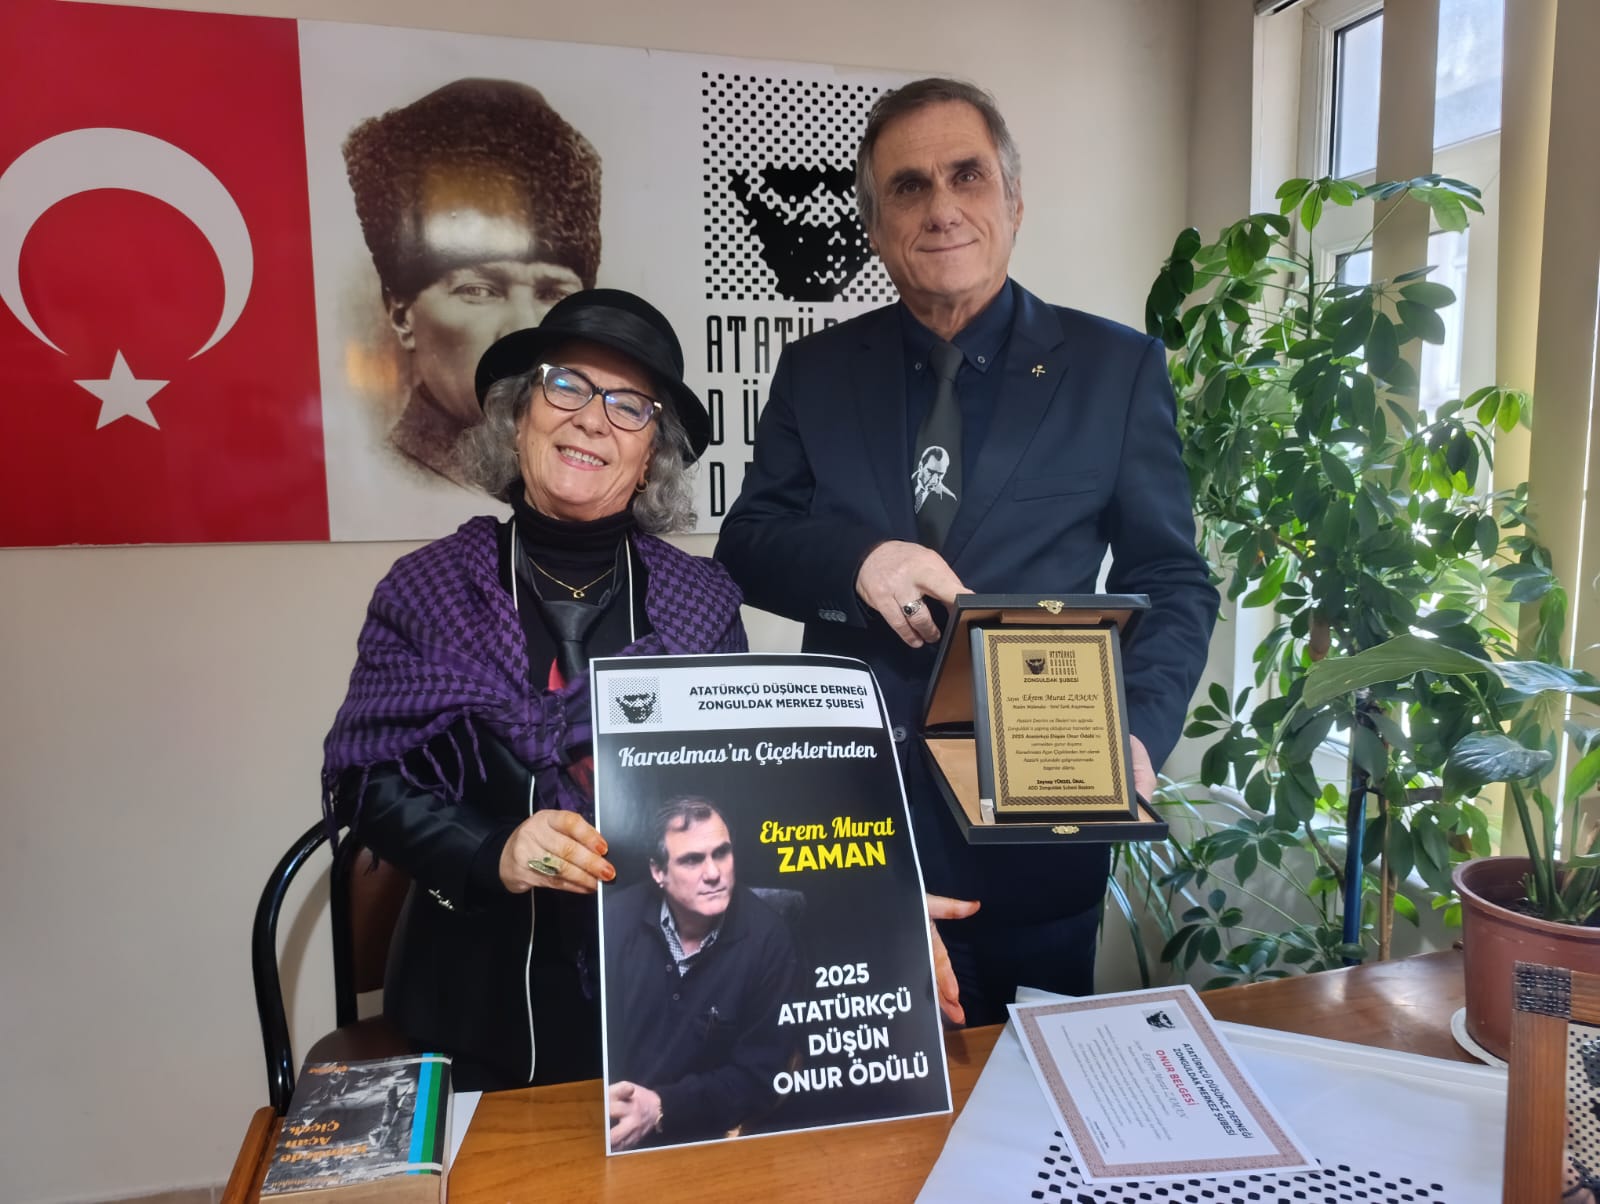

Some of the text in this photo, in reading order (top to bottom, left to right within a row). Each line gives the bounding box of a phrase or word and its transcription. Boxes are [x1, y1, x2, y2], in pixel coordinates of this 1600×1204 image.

[706, 307, 838, 373] ATAT
[689, 682, 867, 697] ATATÜRKÇÜ DÜŞÜNCE DERNEĞİ
[698, 698, 865, 710] ZONGULDAK MERKEZ ŞUBESİ
[755, 740, 877, 765] Çiçeklerinden
[759, 815, 896, 845] Ekrem Murat
[777, 841, 887, 873] ZAMAN
[814, 962, 870, 988] 2025
[777, 986, 912, 1026] ATATÜRKÇÜ
[808, 1024, 890, 1057] DÜŞÜN
[773, 1051, 929, 1095] ONUR ÖDÜLÜ
[1182, 1042, 1211, 1079] ATATÜRKÇÜ
[1155, 1049, 1200, 1106] ONUR BELGESİ
[1173, 1047, 1202, 1086] ZONGULDAK
[1197, 1086, 1220, 1112] MERKEZ
